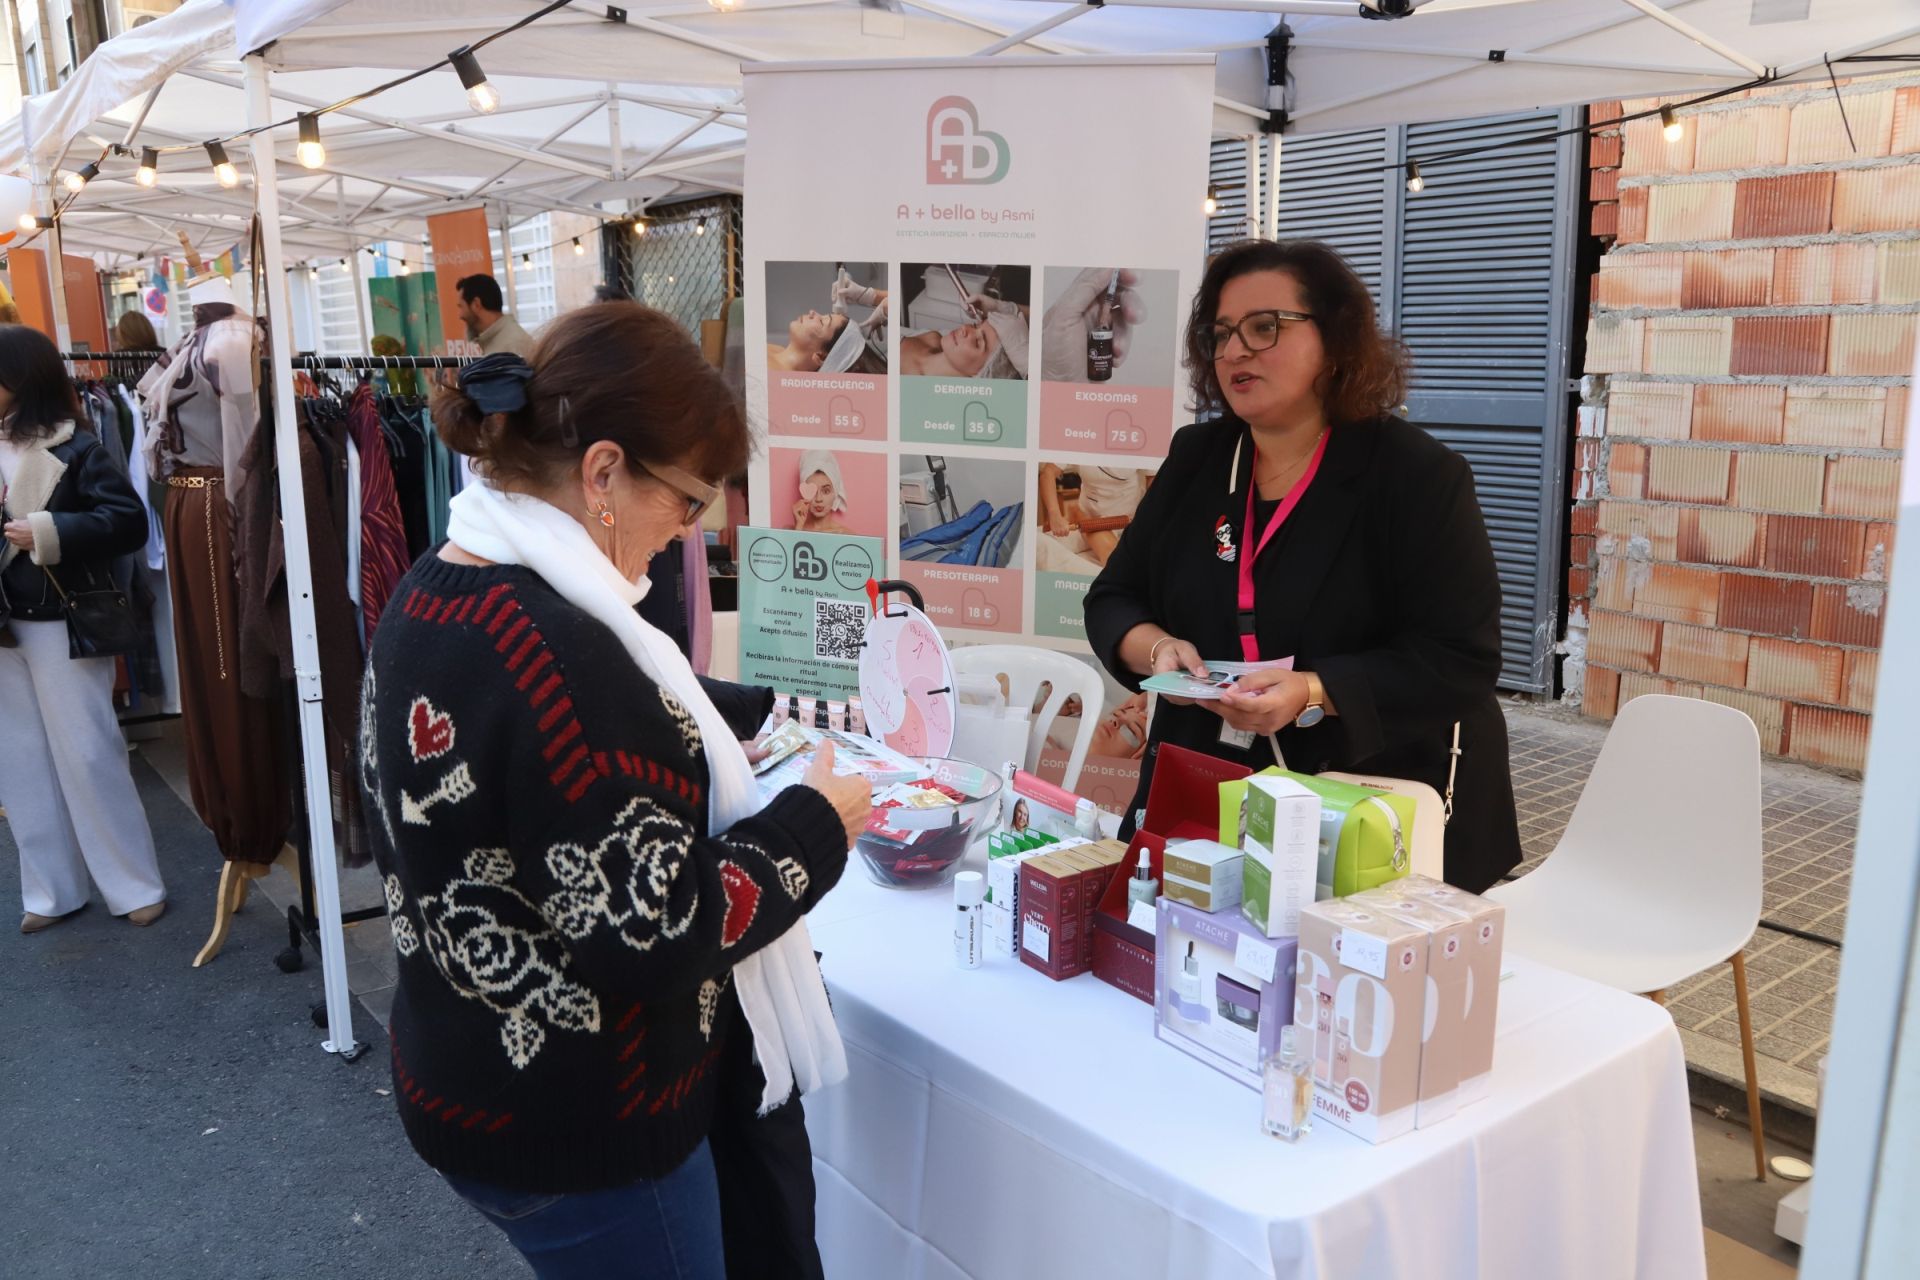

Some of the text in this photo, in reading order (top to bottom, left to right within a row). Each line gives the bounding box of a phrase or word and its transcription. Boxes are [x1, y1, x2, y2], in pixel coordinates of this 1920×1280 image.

[897, 204, 909, 219] A
[931, 203, 975, 220] bella
[981, 208, 998, 224] by
[1002, 209, 1034, 221] Asmi
[781, 378, 875, 390] RADIOFRECUENCIA
[934, 385, 993, 396] DERMAPEN
[1075, 391, 1138, 404] EXOSOMAS
[791, 414, 821, 424] Desde
[835, 416, 849, 426] 55
[924, 420, 955, 431] Desde
[969, 422, 984, 433] 35
[1064, 428, 1096, 439] Desde
[1111, 430, 1127, 442] 75
[835, 560, 871, 569] Realizamos
[924, 569, 999, 584] PRESOTERAPIA
[795, 587, 814, 596] bella
[924, 604, 954, 615] Desde
[968, 606, 980, 618] 18
[1059, 615, 1085, 627] Desd
[759, 626, 781, 636] Acepto
[799, 668, 818, 677] ritual
[790, 677, 828, 688] enviaremos
[828, 682, 842, 690] una
[795, 687, 822, 697] especial
[1101, 767, 1115, 776] DE
[1195, 920, 1230, 942] ATACHE
